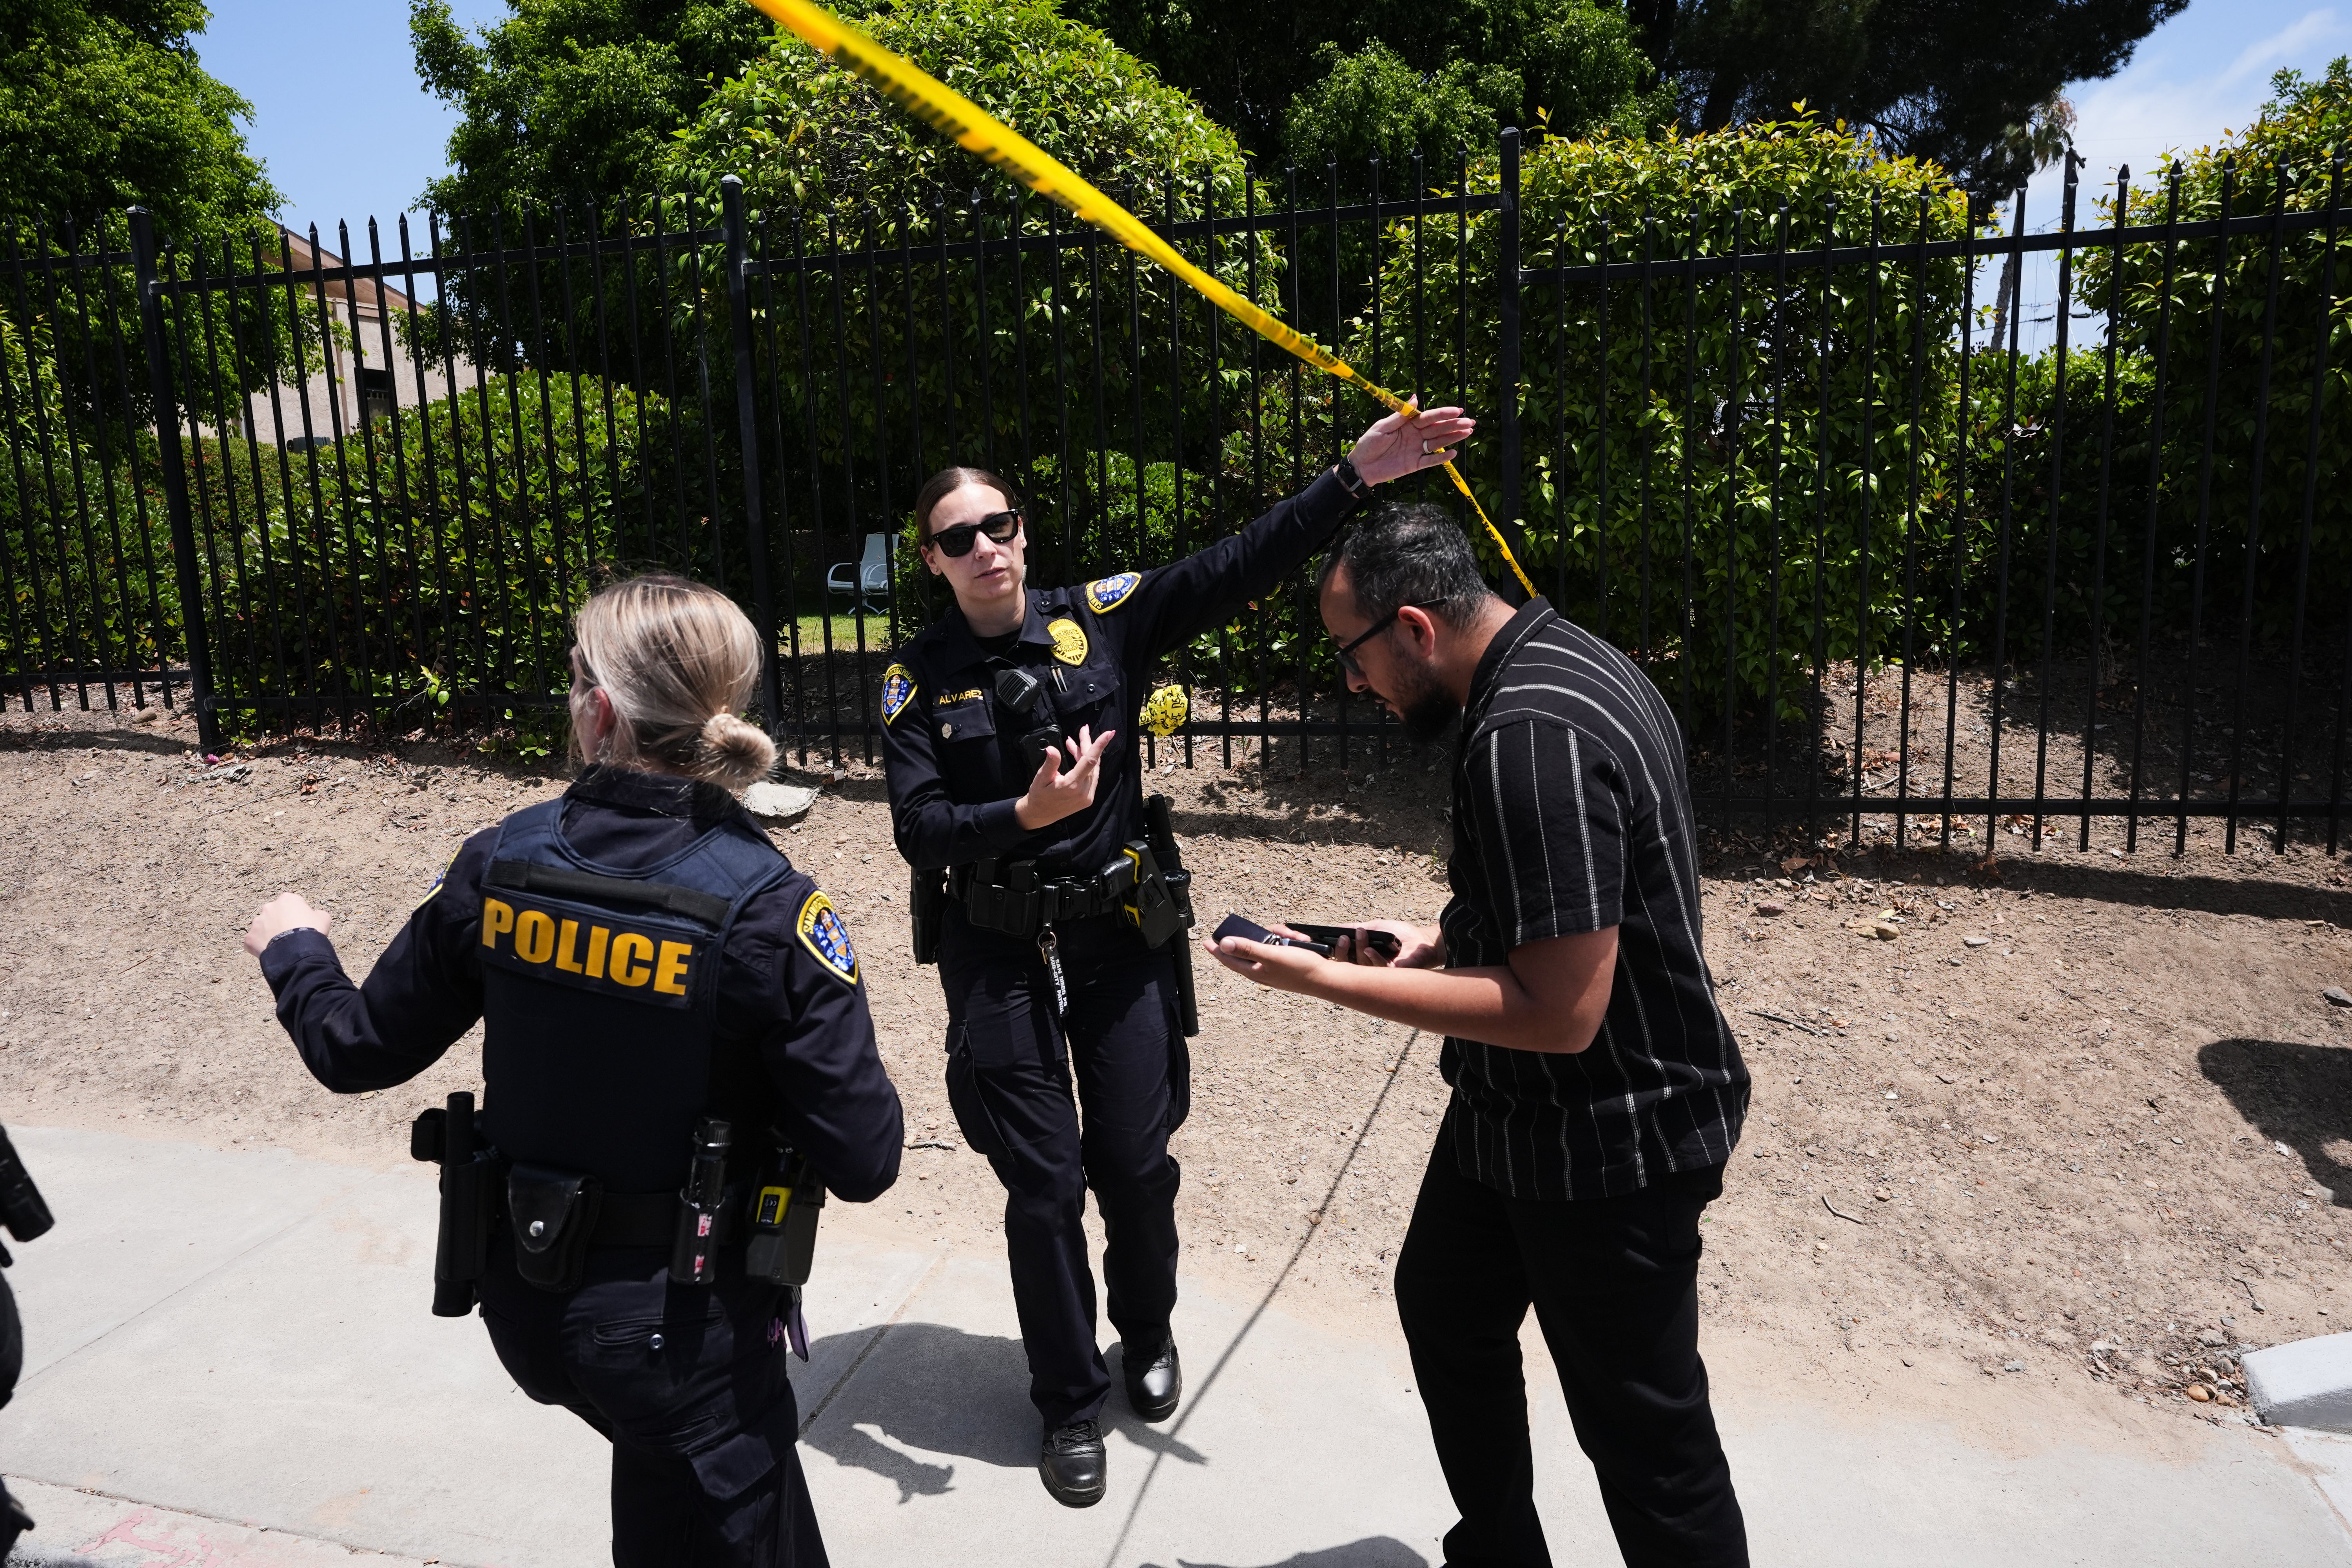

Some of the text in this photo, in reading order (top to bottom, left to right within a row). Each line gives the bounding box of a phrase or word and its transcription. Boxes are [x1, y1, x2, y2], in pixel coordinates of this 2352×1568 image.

[1090, 598, 1103, 609] SAN
[939, 690, 983, 704] ALVAREZ
[803, 913, 816, 934] SAN
[482, 897, 692, 996] POLICE
[1049, 956, 1060, 986] MID-CITY
[1063, 997, 1067, 1007] PD
